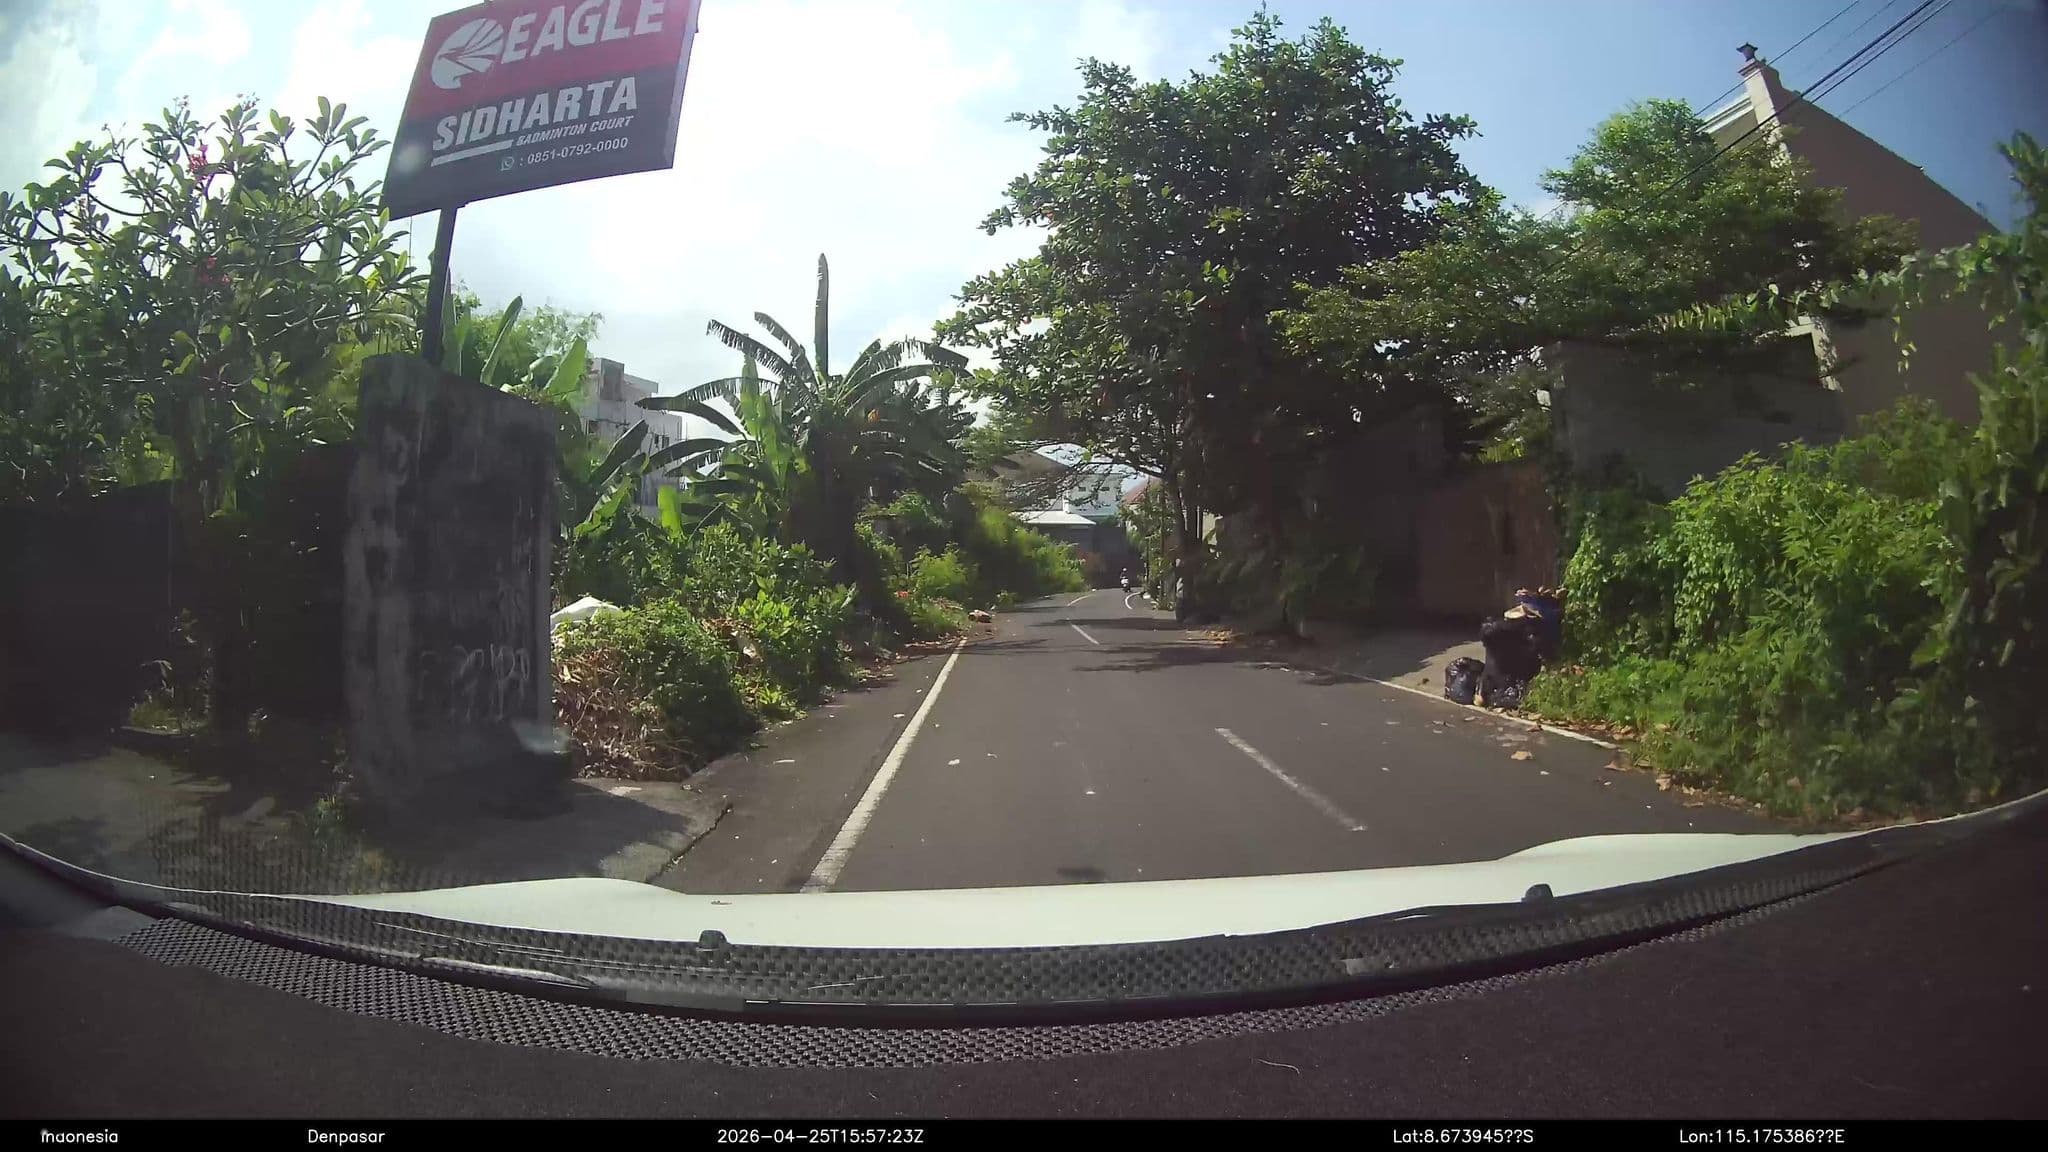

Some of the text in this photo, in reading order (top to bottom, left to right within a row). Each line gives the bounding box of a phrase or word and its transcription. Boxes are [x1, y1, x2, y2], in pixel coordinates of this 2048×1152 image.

[501, 0, 665, 64] EAGLE
[432, 76, 637, 151] SIDHARTA
[516, 115, 635, 146] BADMINTON COURT
[527, 137, 629, 165] 0851-0792-0000
